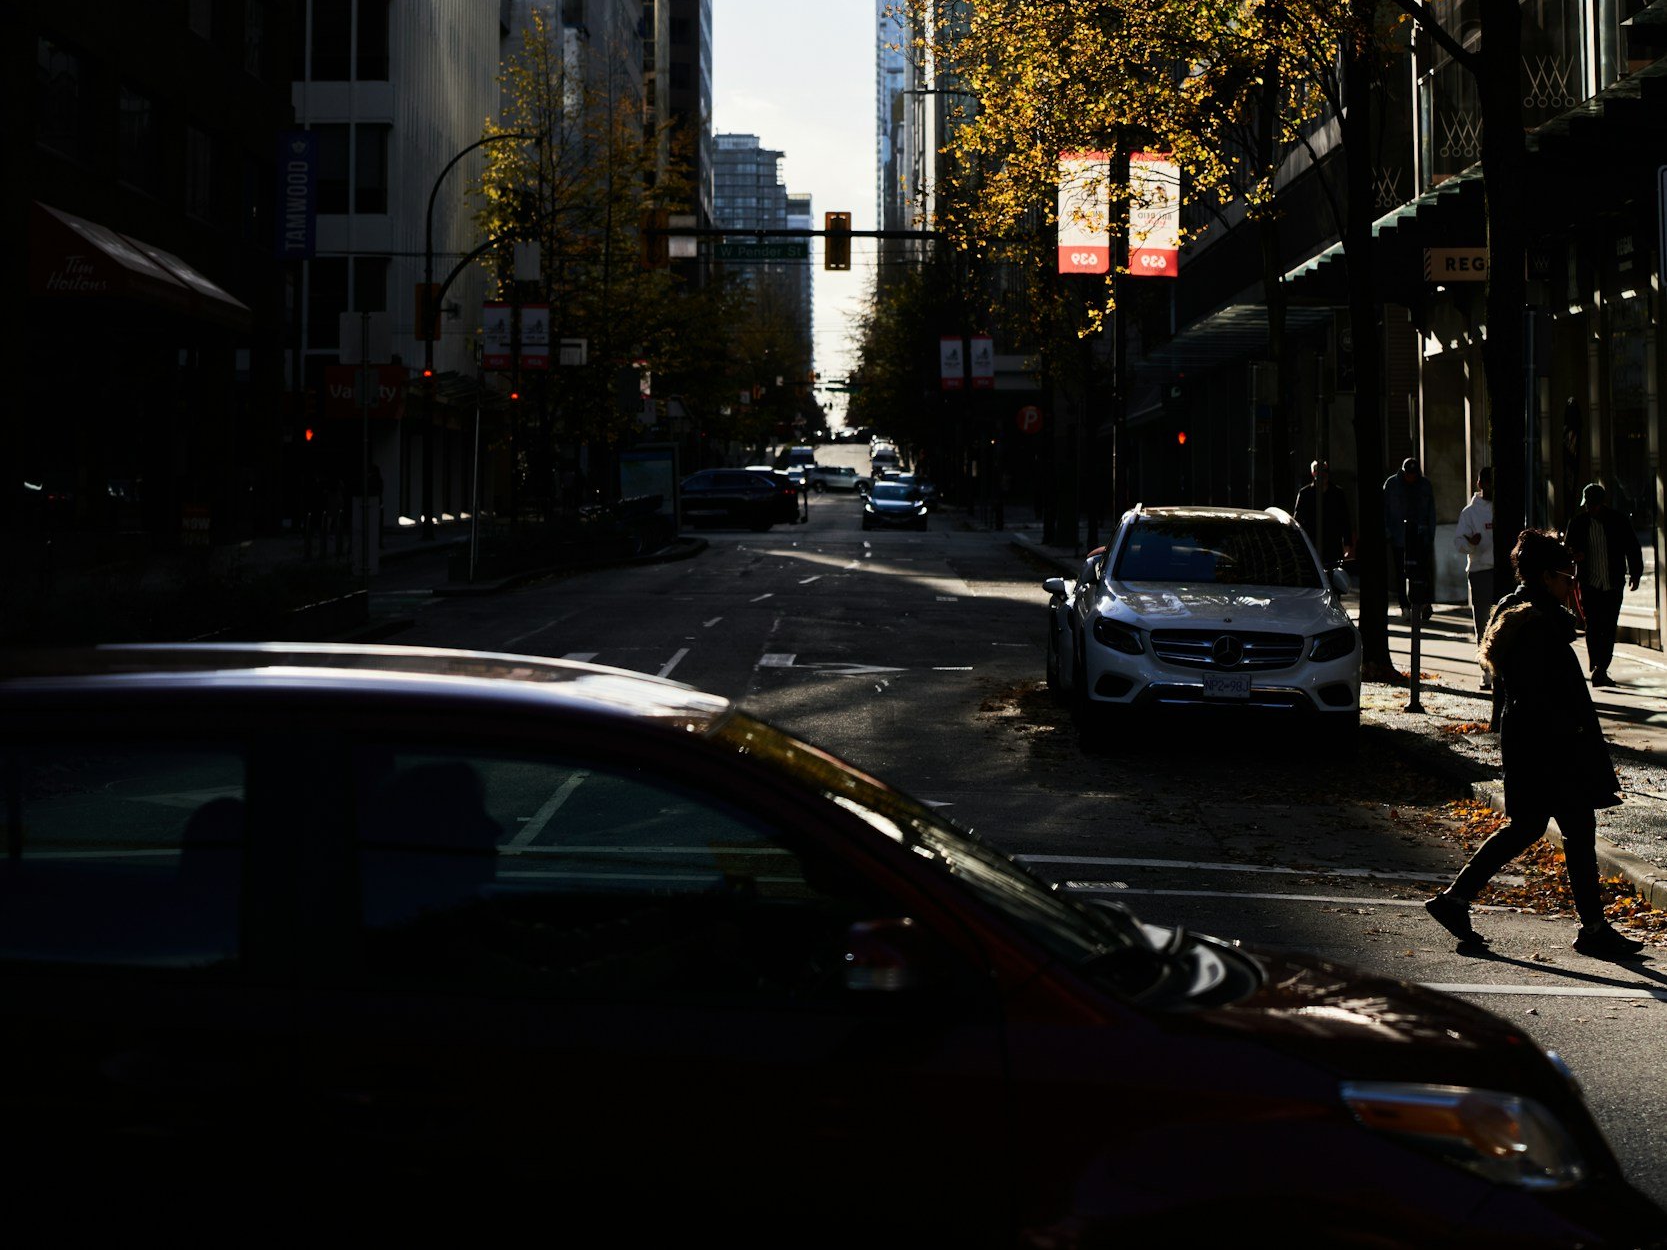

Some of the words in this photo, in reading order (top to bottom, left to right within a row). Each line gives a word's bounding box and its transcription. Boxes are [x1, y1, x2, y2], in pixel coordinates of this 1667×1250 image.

[285, 160, 309, 251] TAMWOOD
[720, 246, 733, 256] W
[738, 246, 782, 257] Pender
[787, 245, 802, 256] St
[64, 254, 96, 274] Tim
[46, 271, 108, 291] Hortons
[329, 383, 396, 403] Vaty
[1023, 410, 1039, 430] P
